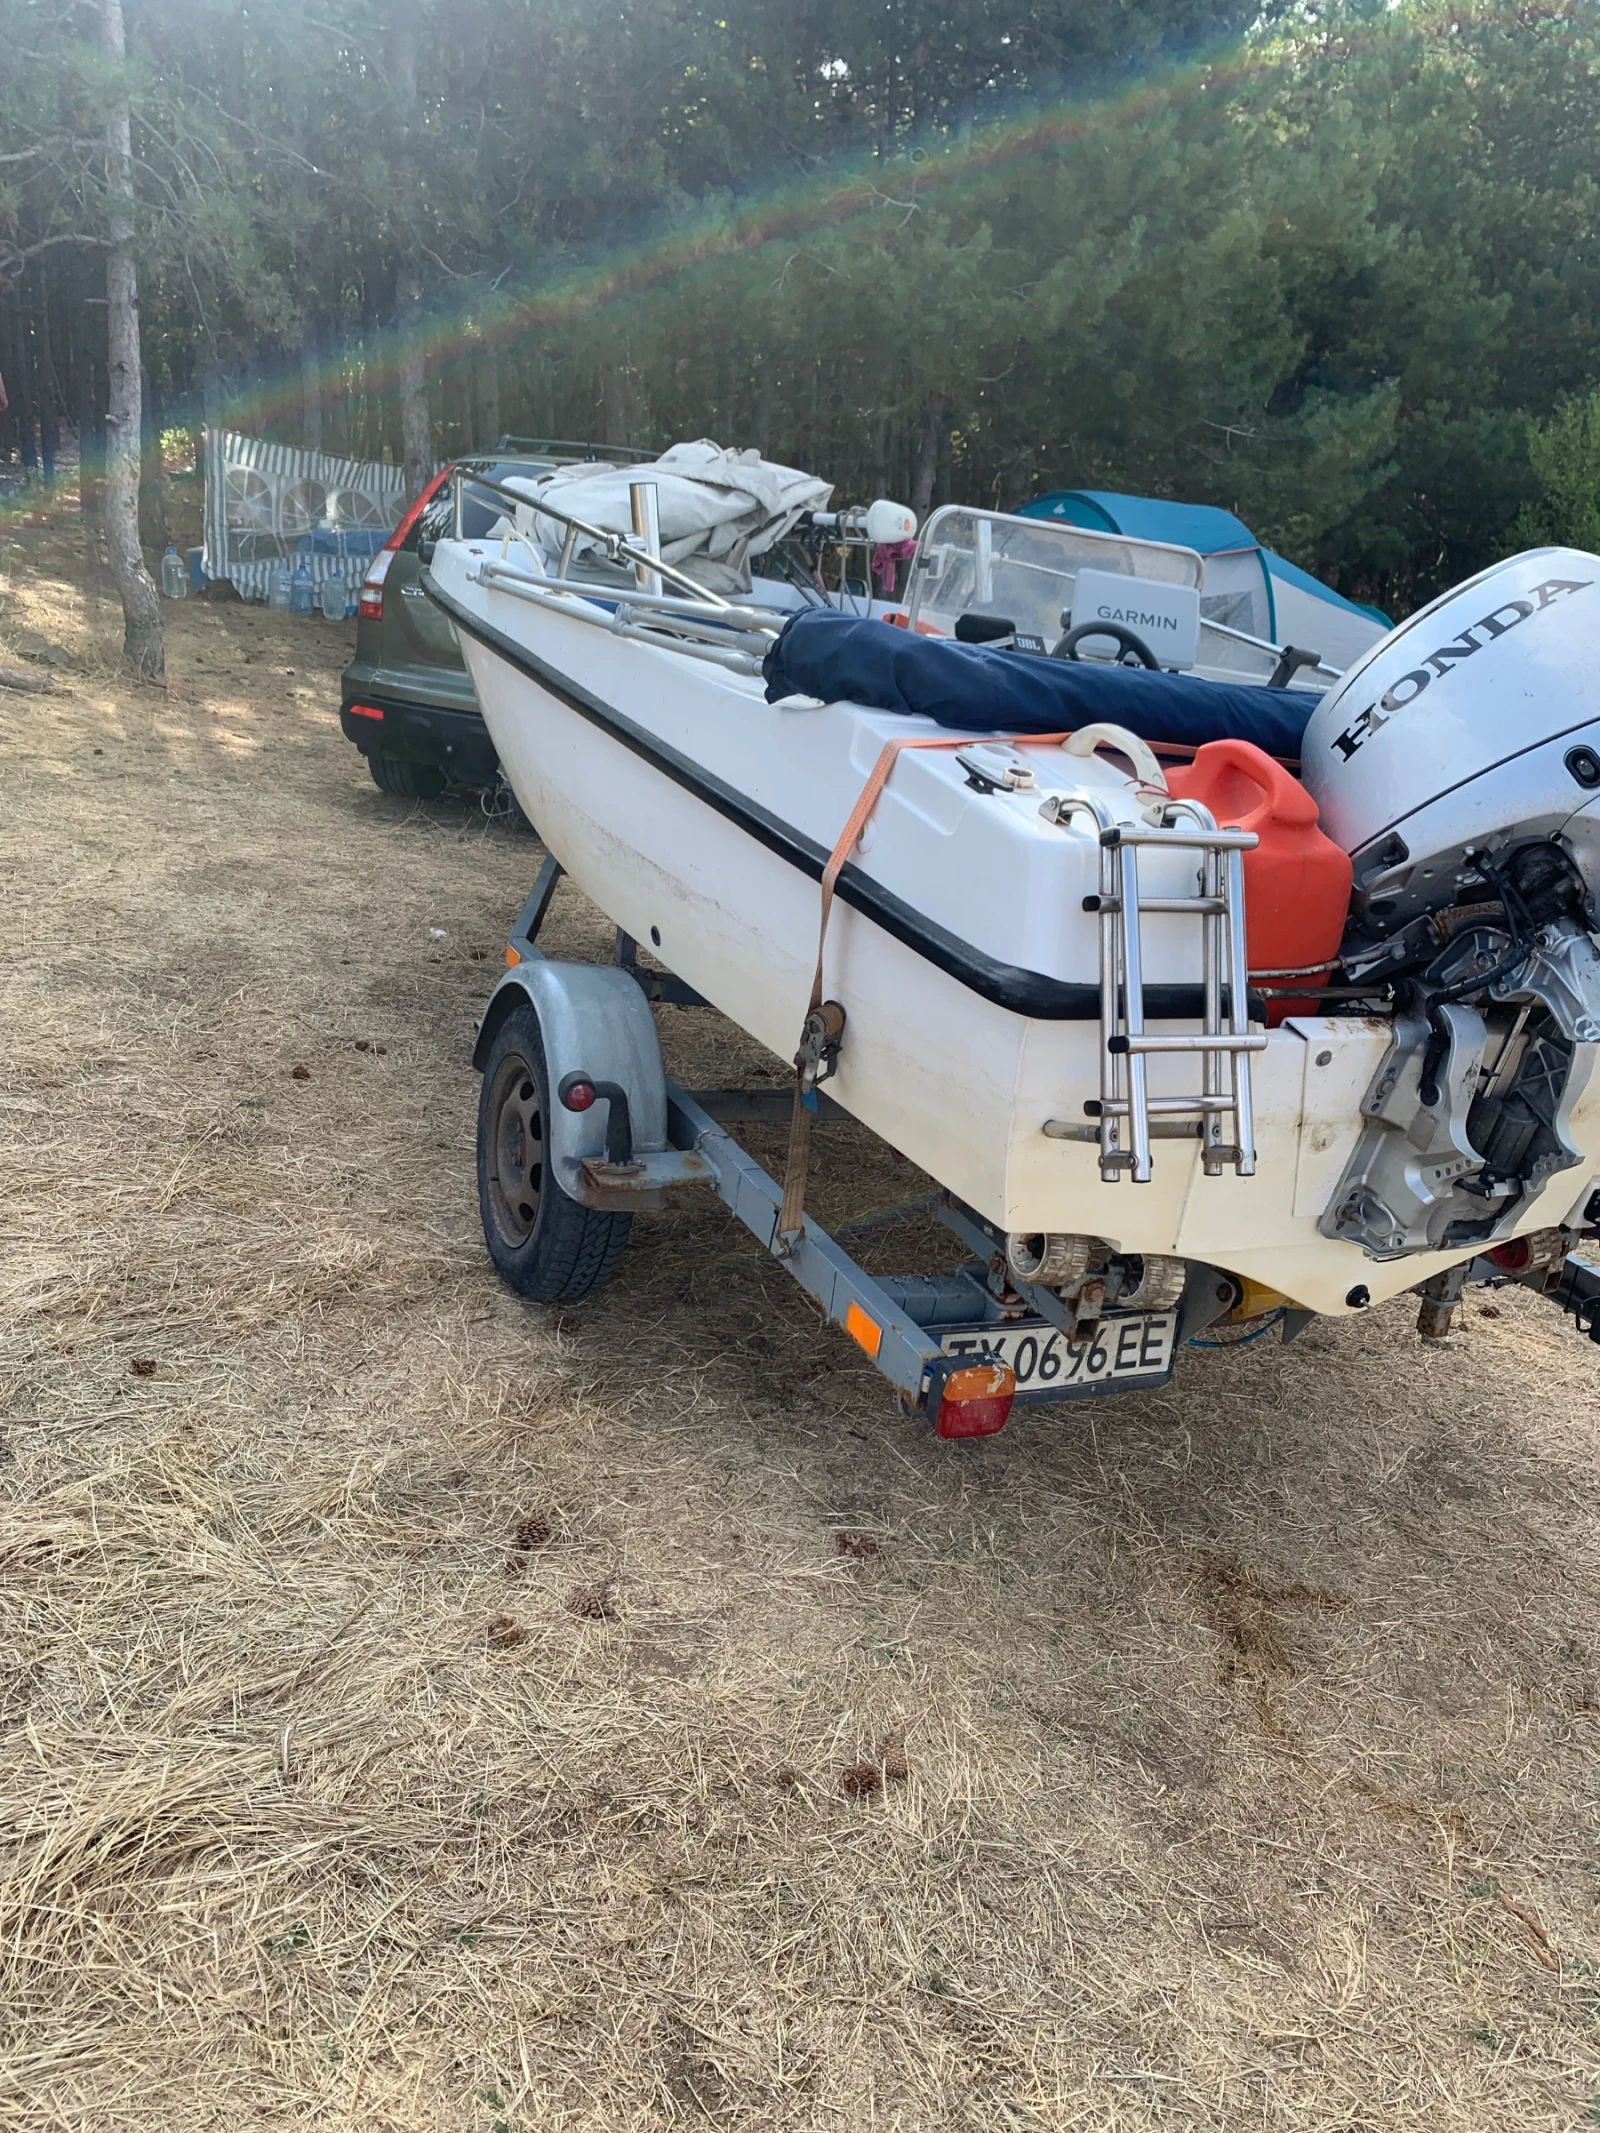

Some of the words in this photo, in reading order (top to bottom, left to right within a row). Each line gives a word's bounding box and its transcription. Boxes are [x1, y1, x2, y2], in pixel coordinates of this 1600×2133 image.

[1096, 605, 1178, 631] GARMIN
[1016, 637, 1041, 651] JBL
[1330, 578, 1595, 763] HONDA
